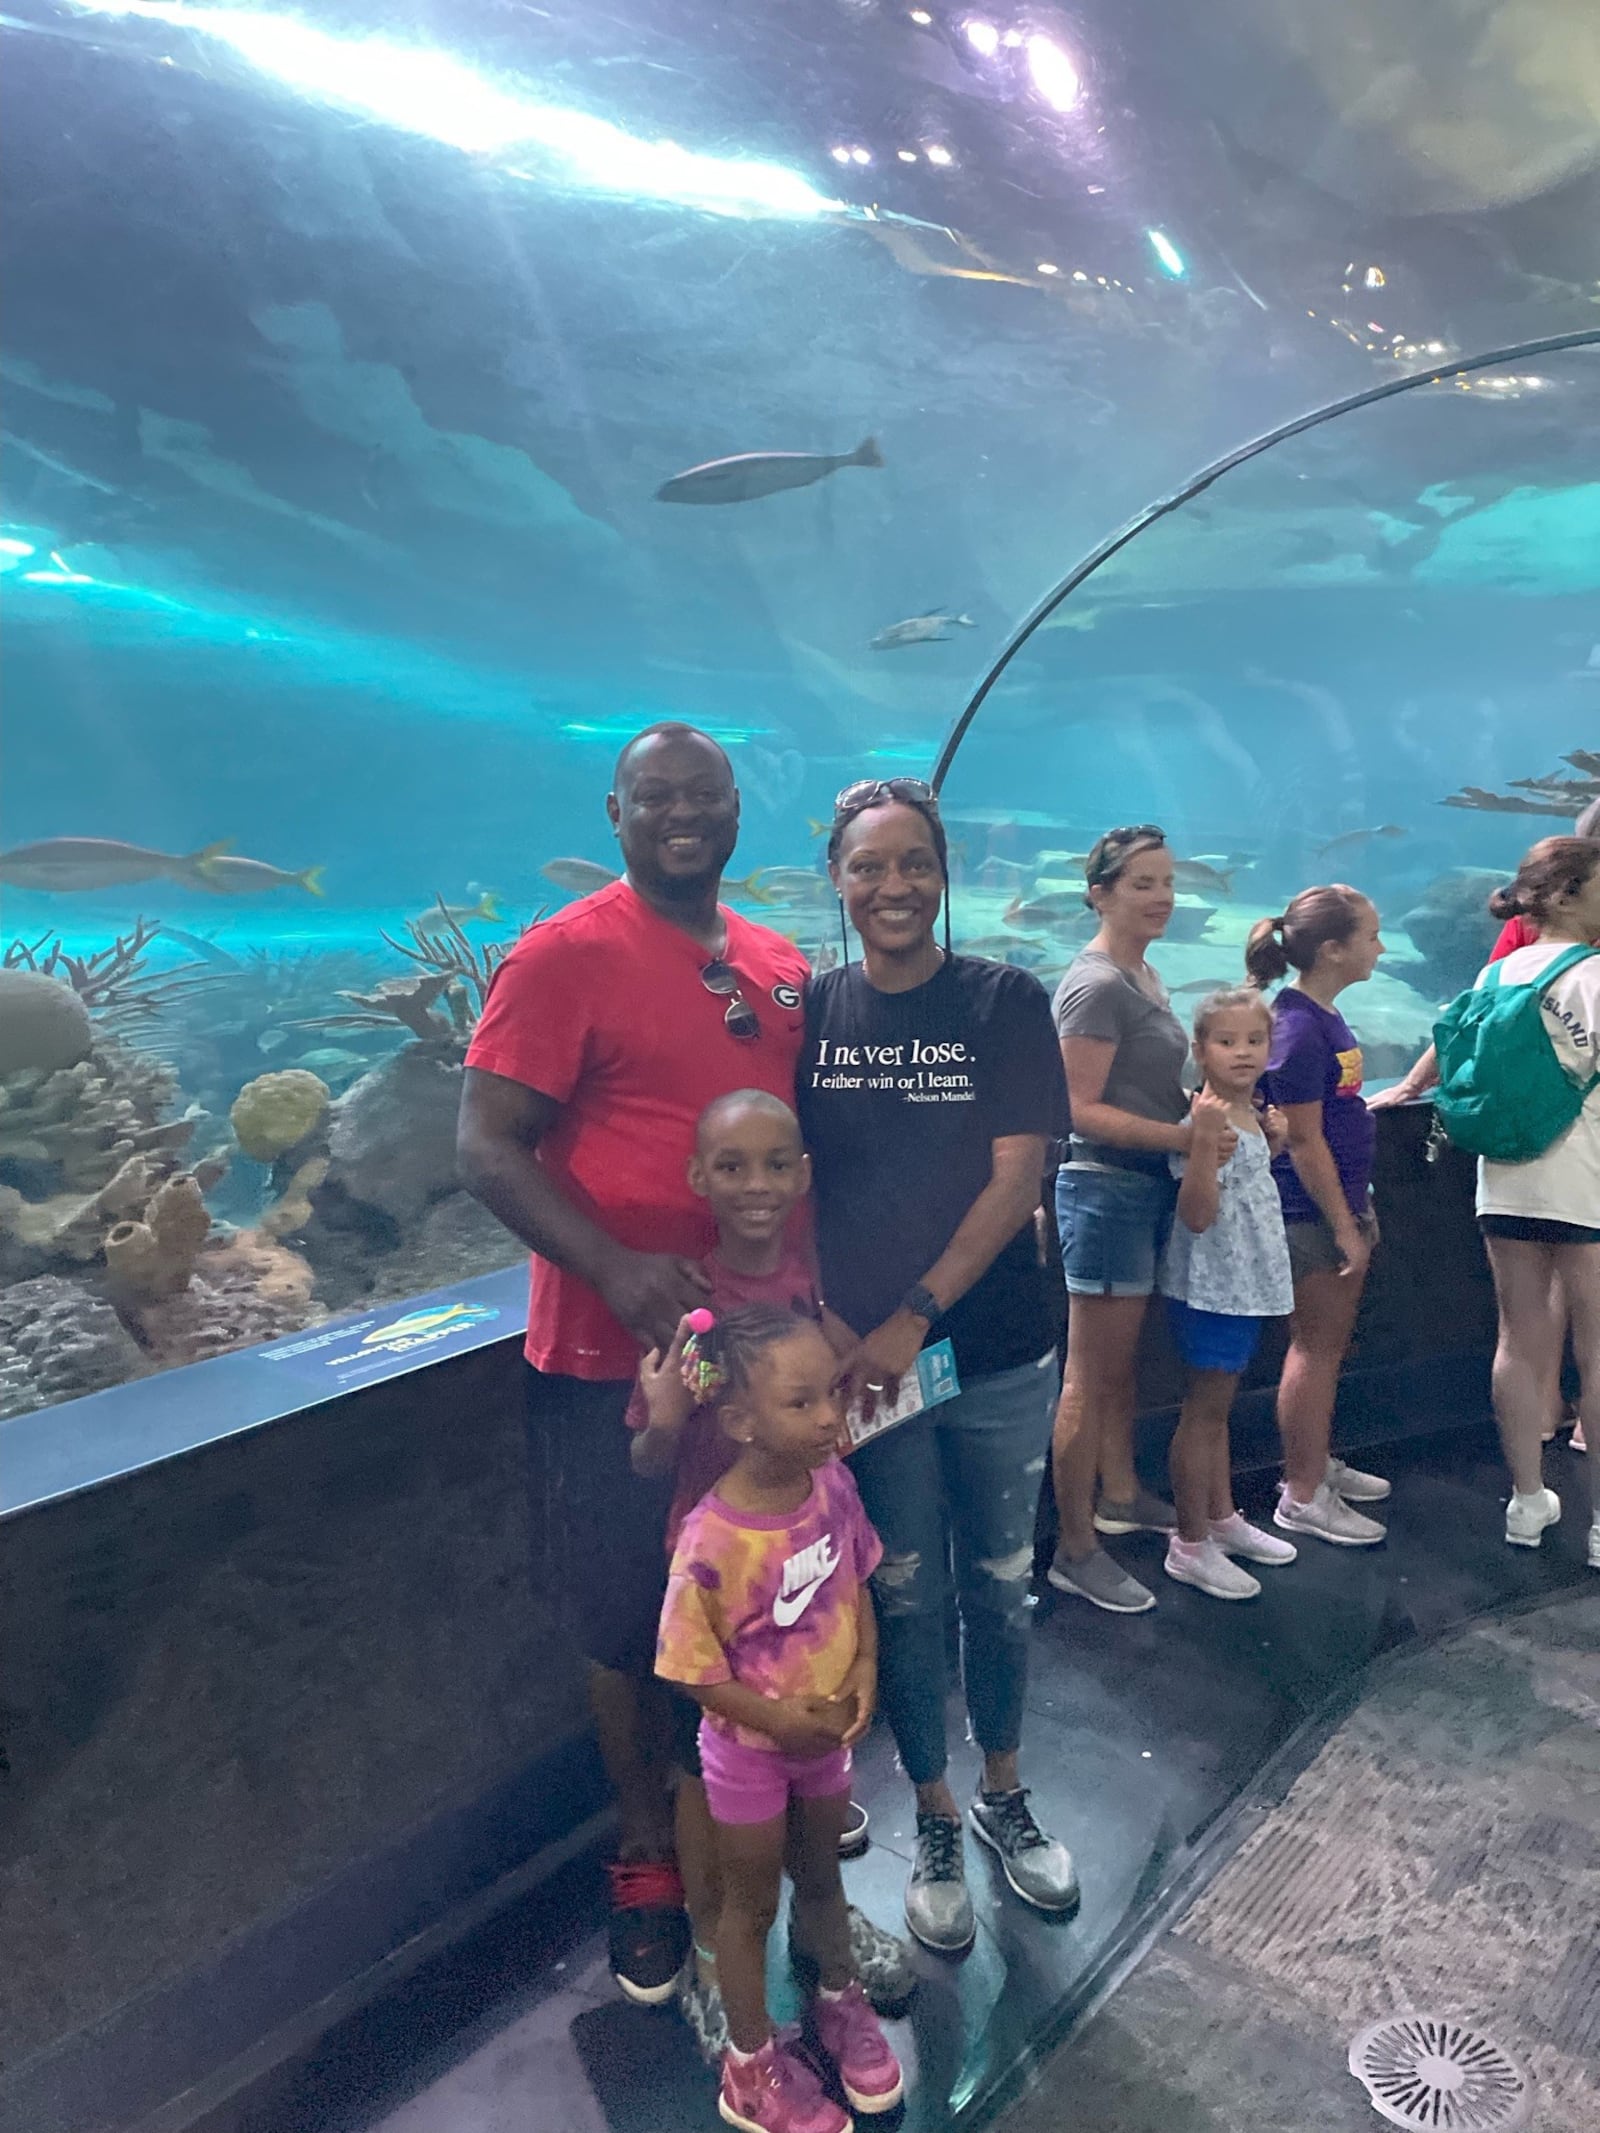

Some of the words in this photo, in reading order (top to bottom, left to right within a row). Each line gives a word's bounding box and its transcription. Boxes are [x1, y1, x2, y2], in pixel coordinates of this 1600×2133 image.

[772, 984, 801, 1010] G
[1542, 997, 1589, 1048] SLAND
[815, 1039, 830, 1066] I
[909, 1039, 977, 1065] lose.
[811, 1072, 820, 1088] I
[821, 1072, 865, 1089] either
[867, 1072, 894, 1089] win
[897, 1078, 916, 1089] or
[917, 1071, 924, 1089] I
[928, 1071, 974, 1088] learn.
[941, 1091, 977, 1102] Mandel
